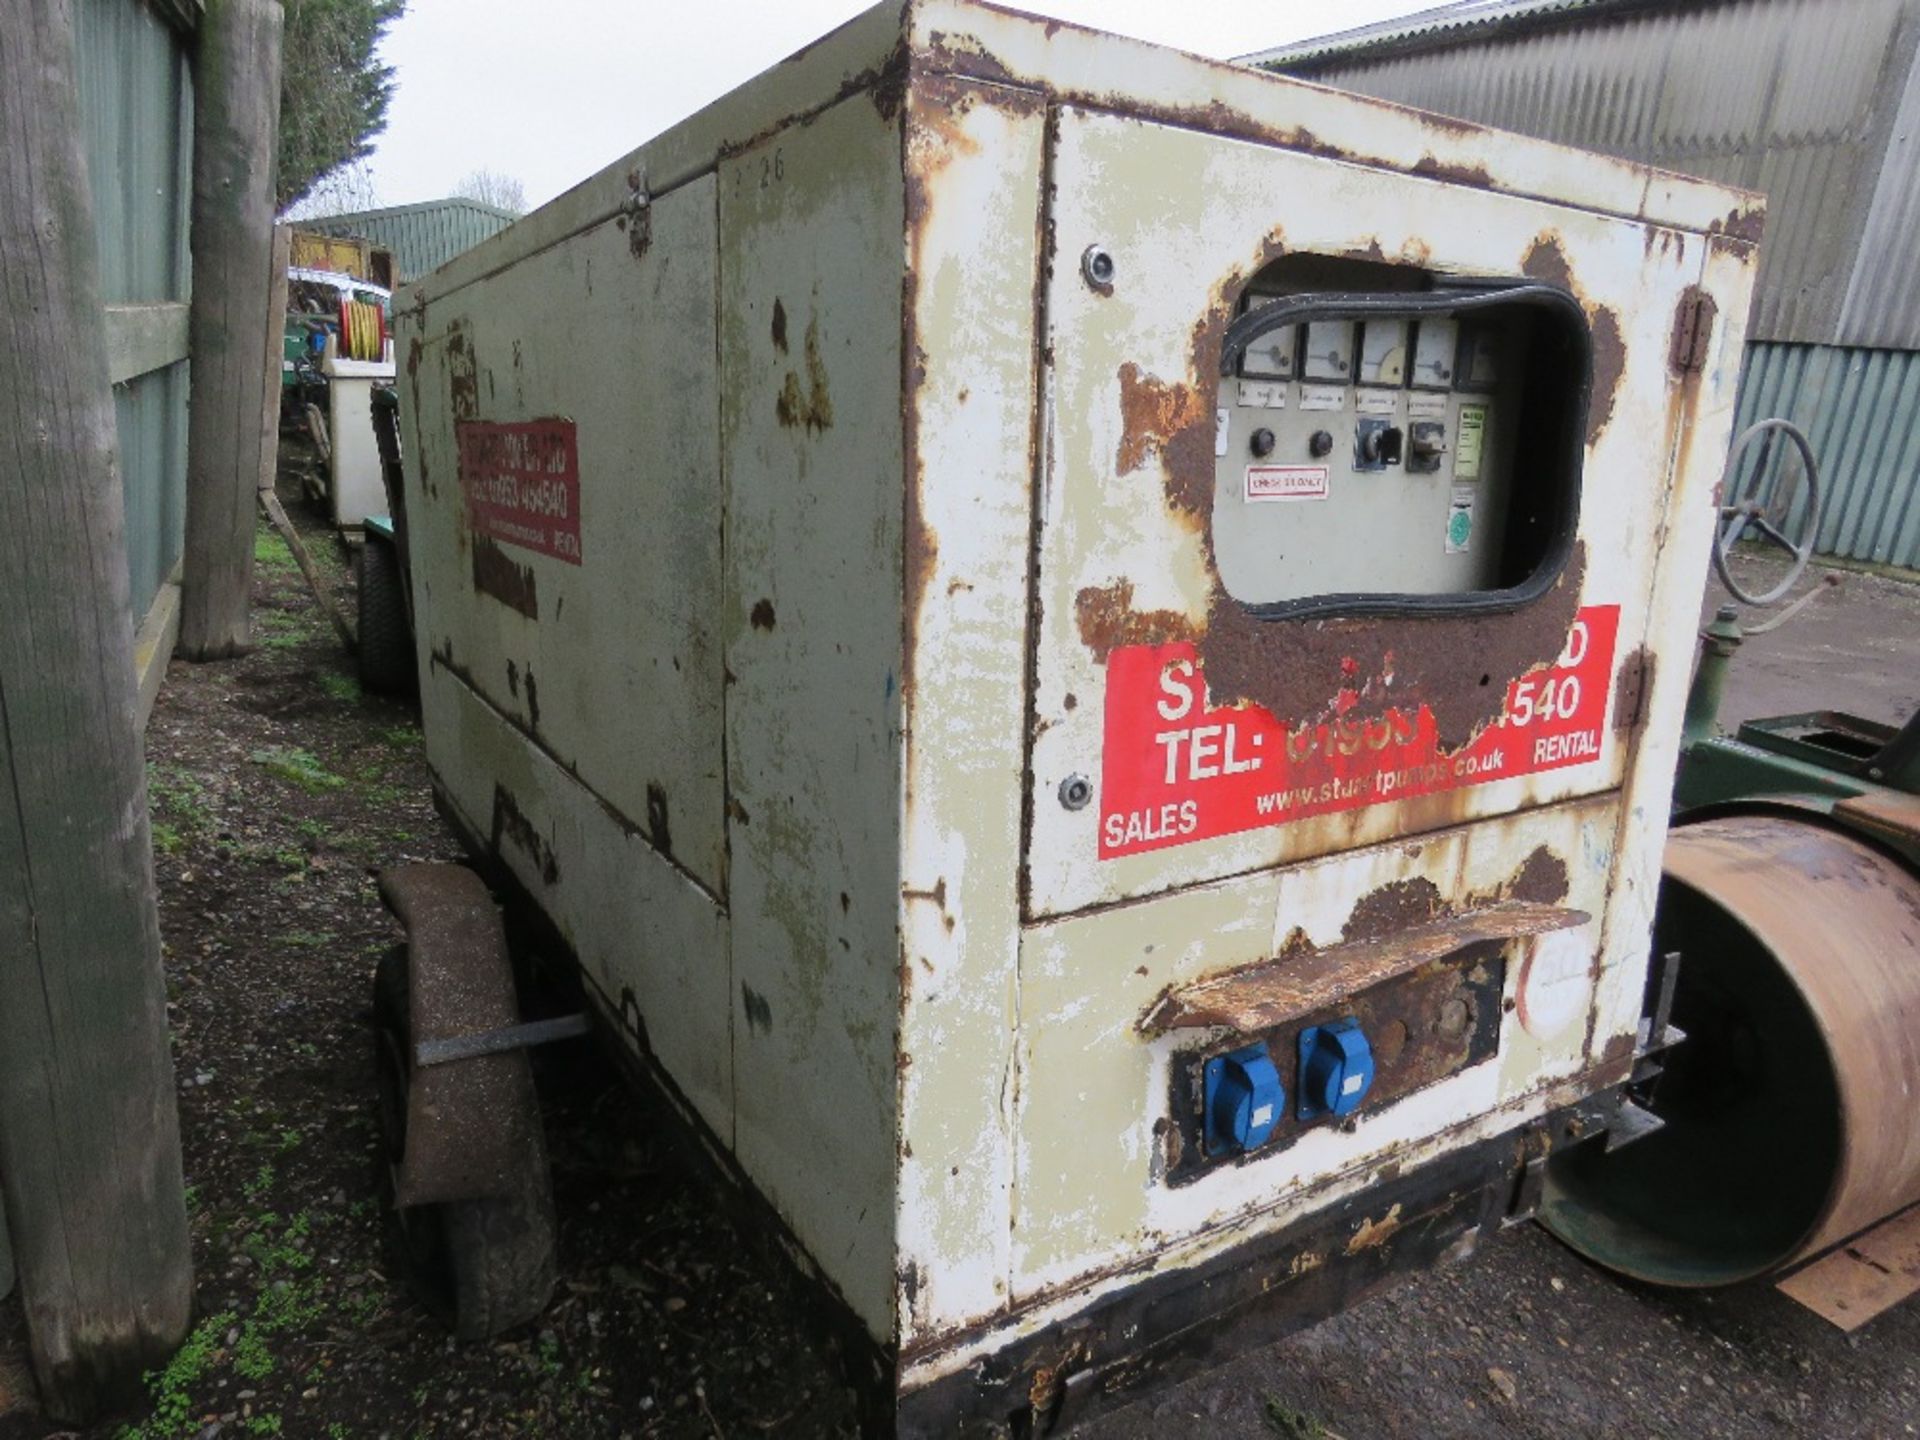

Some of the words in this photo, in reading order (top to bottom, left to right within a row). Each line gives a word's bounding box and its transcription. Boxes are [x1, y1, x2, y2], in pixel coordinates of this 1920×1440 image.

[1104, 799, 1198, 848] SALES
[1257, 748, 1504, 816] www.stuatpumpsco.uk
[1533, 729, 1599, 765] RENTAL
[1155, 722, 1264, 785] TEL:
